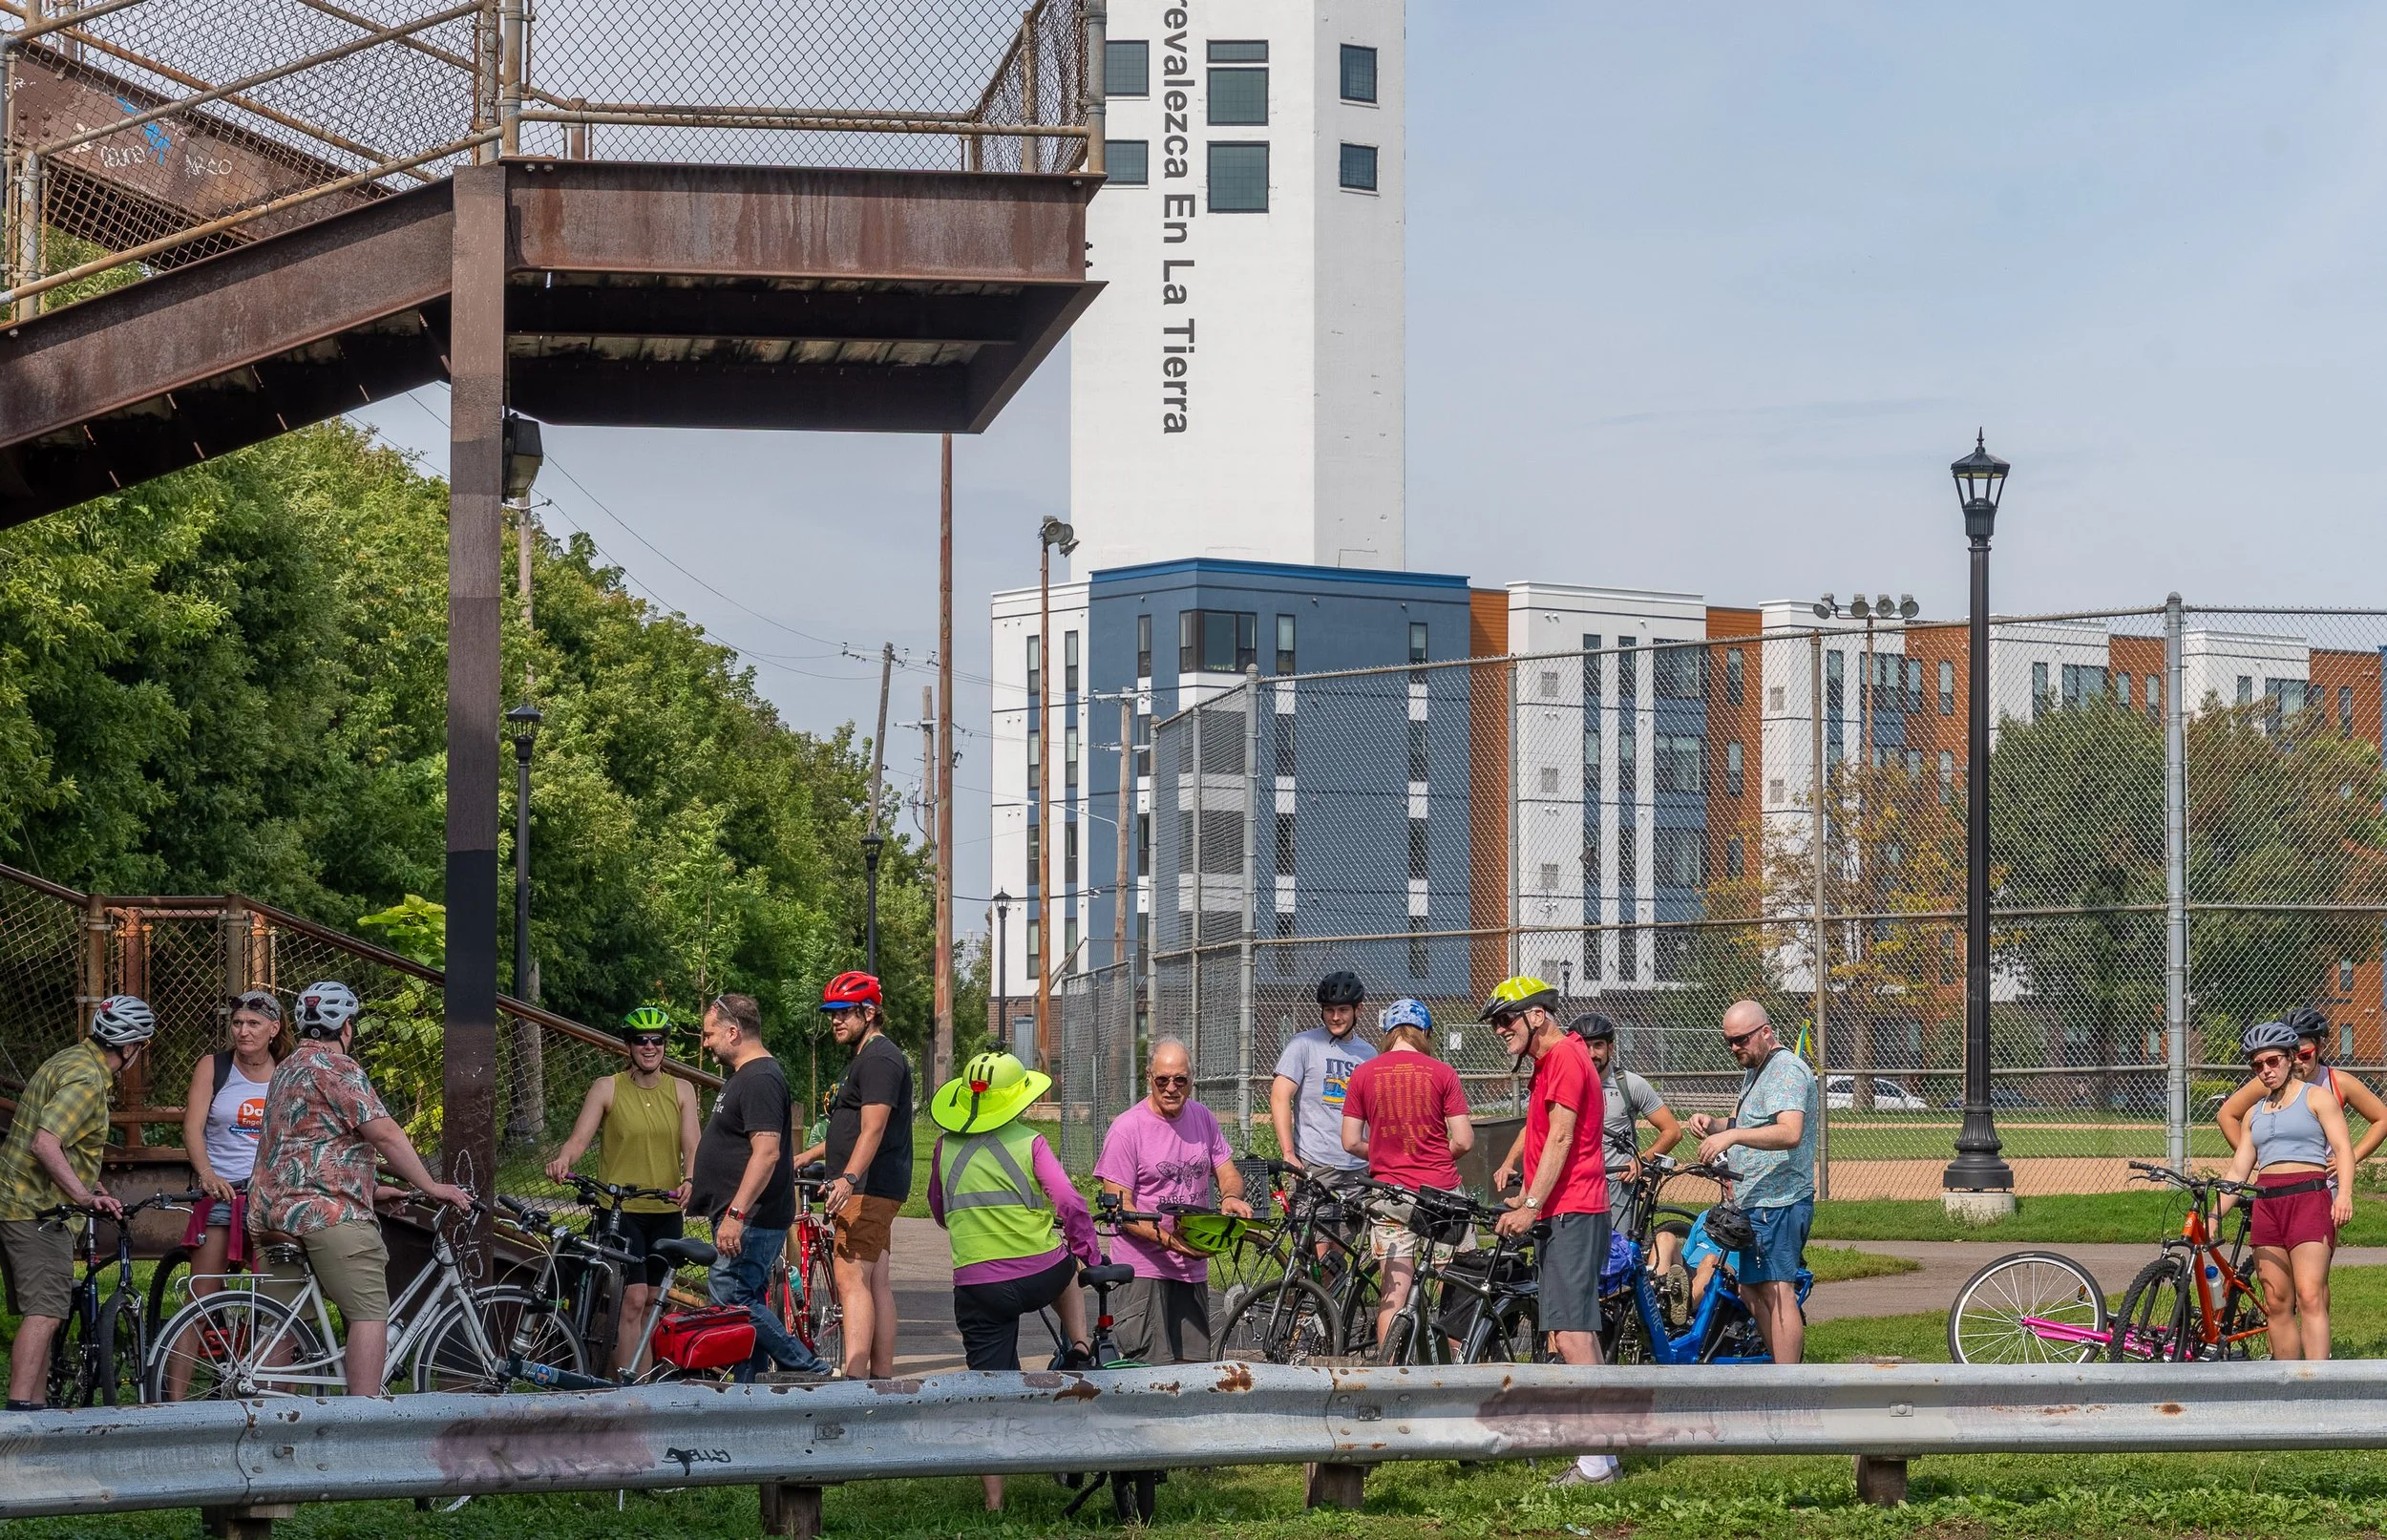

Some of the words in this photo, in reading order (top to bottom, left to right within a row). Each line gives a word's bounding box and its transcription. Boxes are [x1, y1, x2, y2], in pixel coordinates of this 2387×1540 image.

[1163, 194, 1195, 243] En
[1163, 260, 1195, 306] La
[1163, 318, 1195, 434] Tierra
[1326, 1058, 1360, 1077] ITS
[243, 1118, 263, 1127] Engel
[1159, 1195, 1185, 1205] BARE
[1427, 1324, 1440, 1365] TRE
